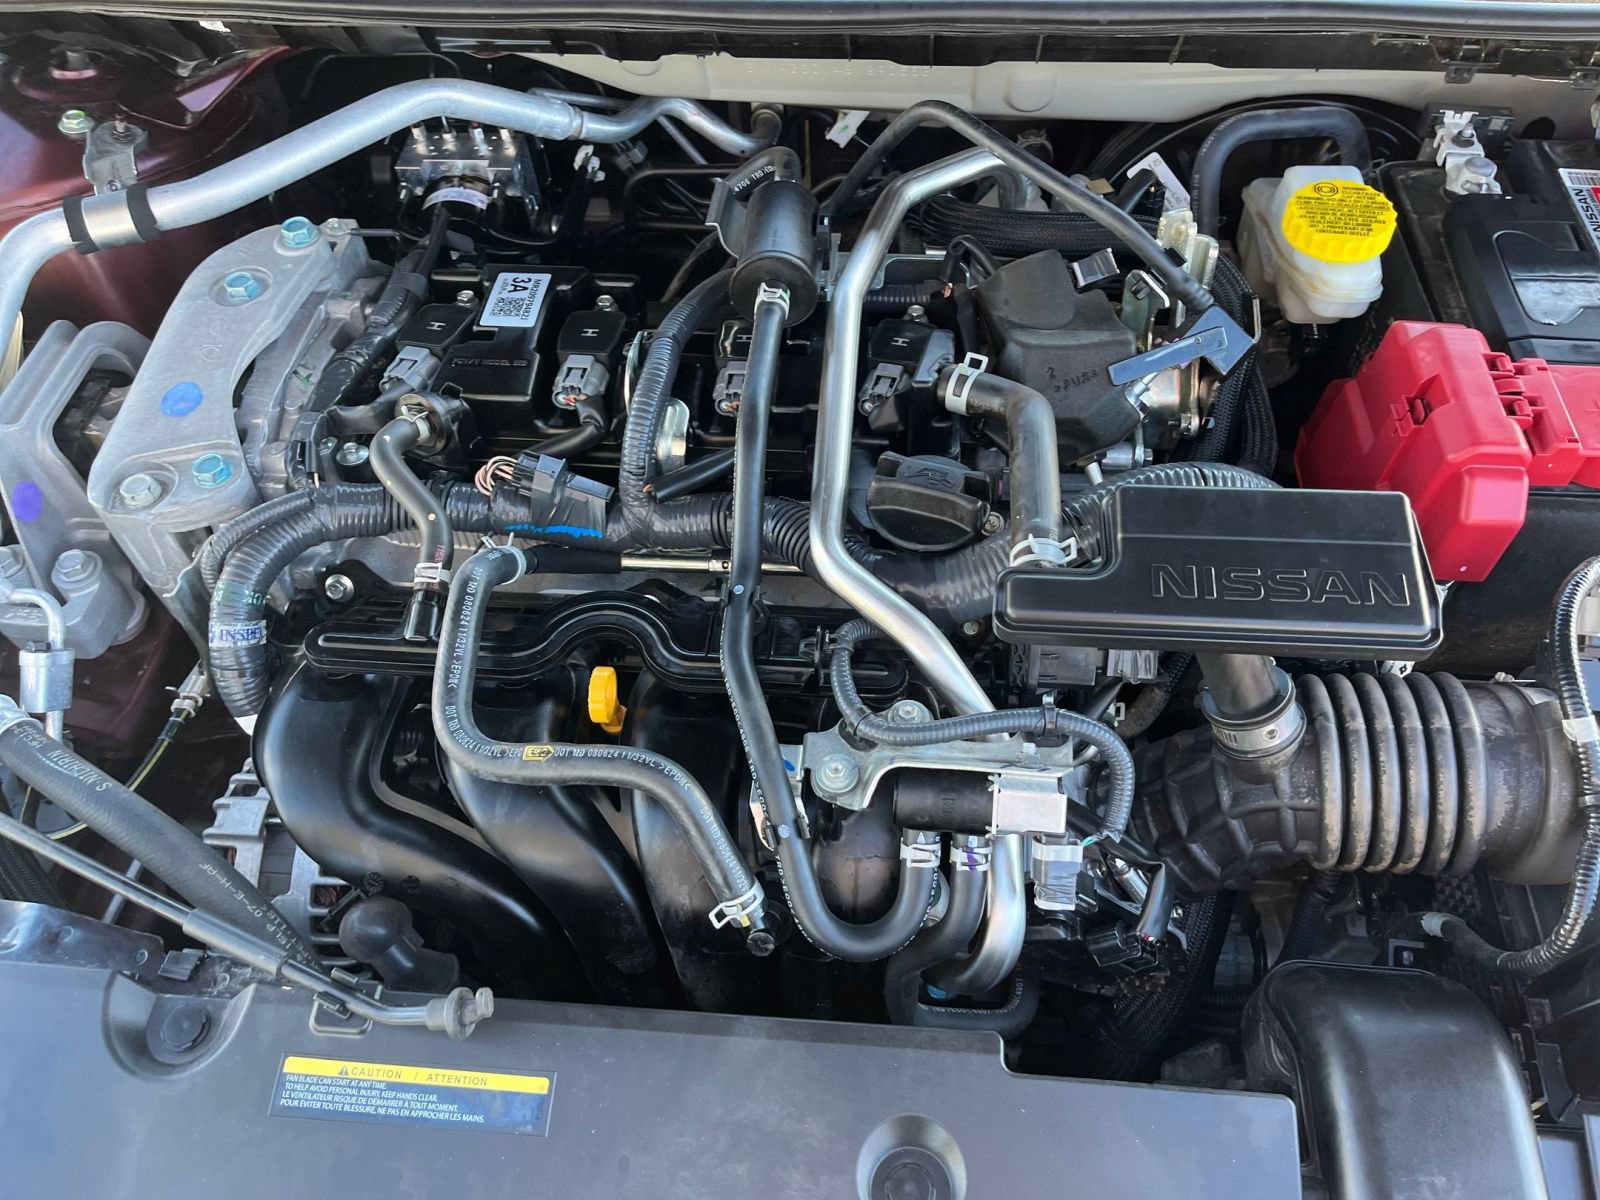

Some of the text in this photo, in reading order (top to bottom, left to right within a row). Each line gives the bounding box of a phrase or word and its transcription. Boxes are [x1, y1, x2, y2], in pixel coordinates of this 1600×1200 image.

[508, 277, 532, 293] 3A
[1151, 564, 1410, 606] NISSAN
[459, 595, 474, 625] 080624
[587, 750, 618, 758] 080624
[286, 1073, 388, 1090] FAN BLADE CAN START AT ANY TIME.
[351, 1066, 403, 1080] CAUTION
[426, 1072, 488, 1087] ATTENTION
[282, 1090, 291, 1098] LE
[291, 1091, 334, 1103] VENTILATEUR
[333, 1094, 358, 1105] RISQUE
[358, 1096, 367, 1104] DE
[367, 1096, 404, 1108] DÉMARRER
[410, 1100, 427, 1109] TOUT
[285, 1082, 294, 1090] TO
[294, 1083, 309, 1091] HELP
[309, 1084, 328, 1093] AVOID
[328, 1085, 360, 1096] PERSONAL
[381, 1089, 396, 1099] KEEP
[397, 1090, 418, 1100] HANDS
[280, 1098, 299, 1107] POUR
[299, 1098, 322, 1109] ÉVITER
[322, 1101, 343, 1111] TOUTE
[377, 1105, 387, 1115] NE
[387, 1106, 400, 1116] PAS
[400, 1107, 410, 1117] EN
[410, 1108, 449, 1121] APPROCHER
[449, 1112, 461, 1121] LES
